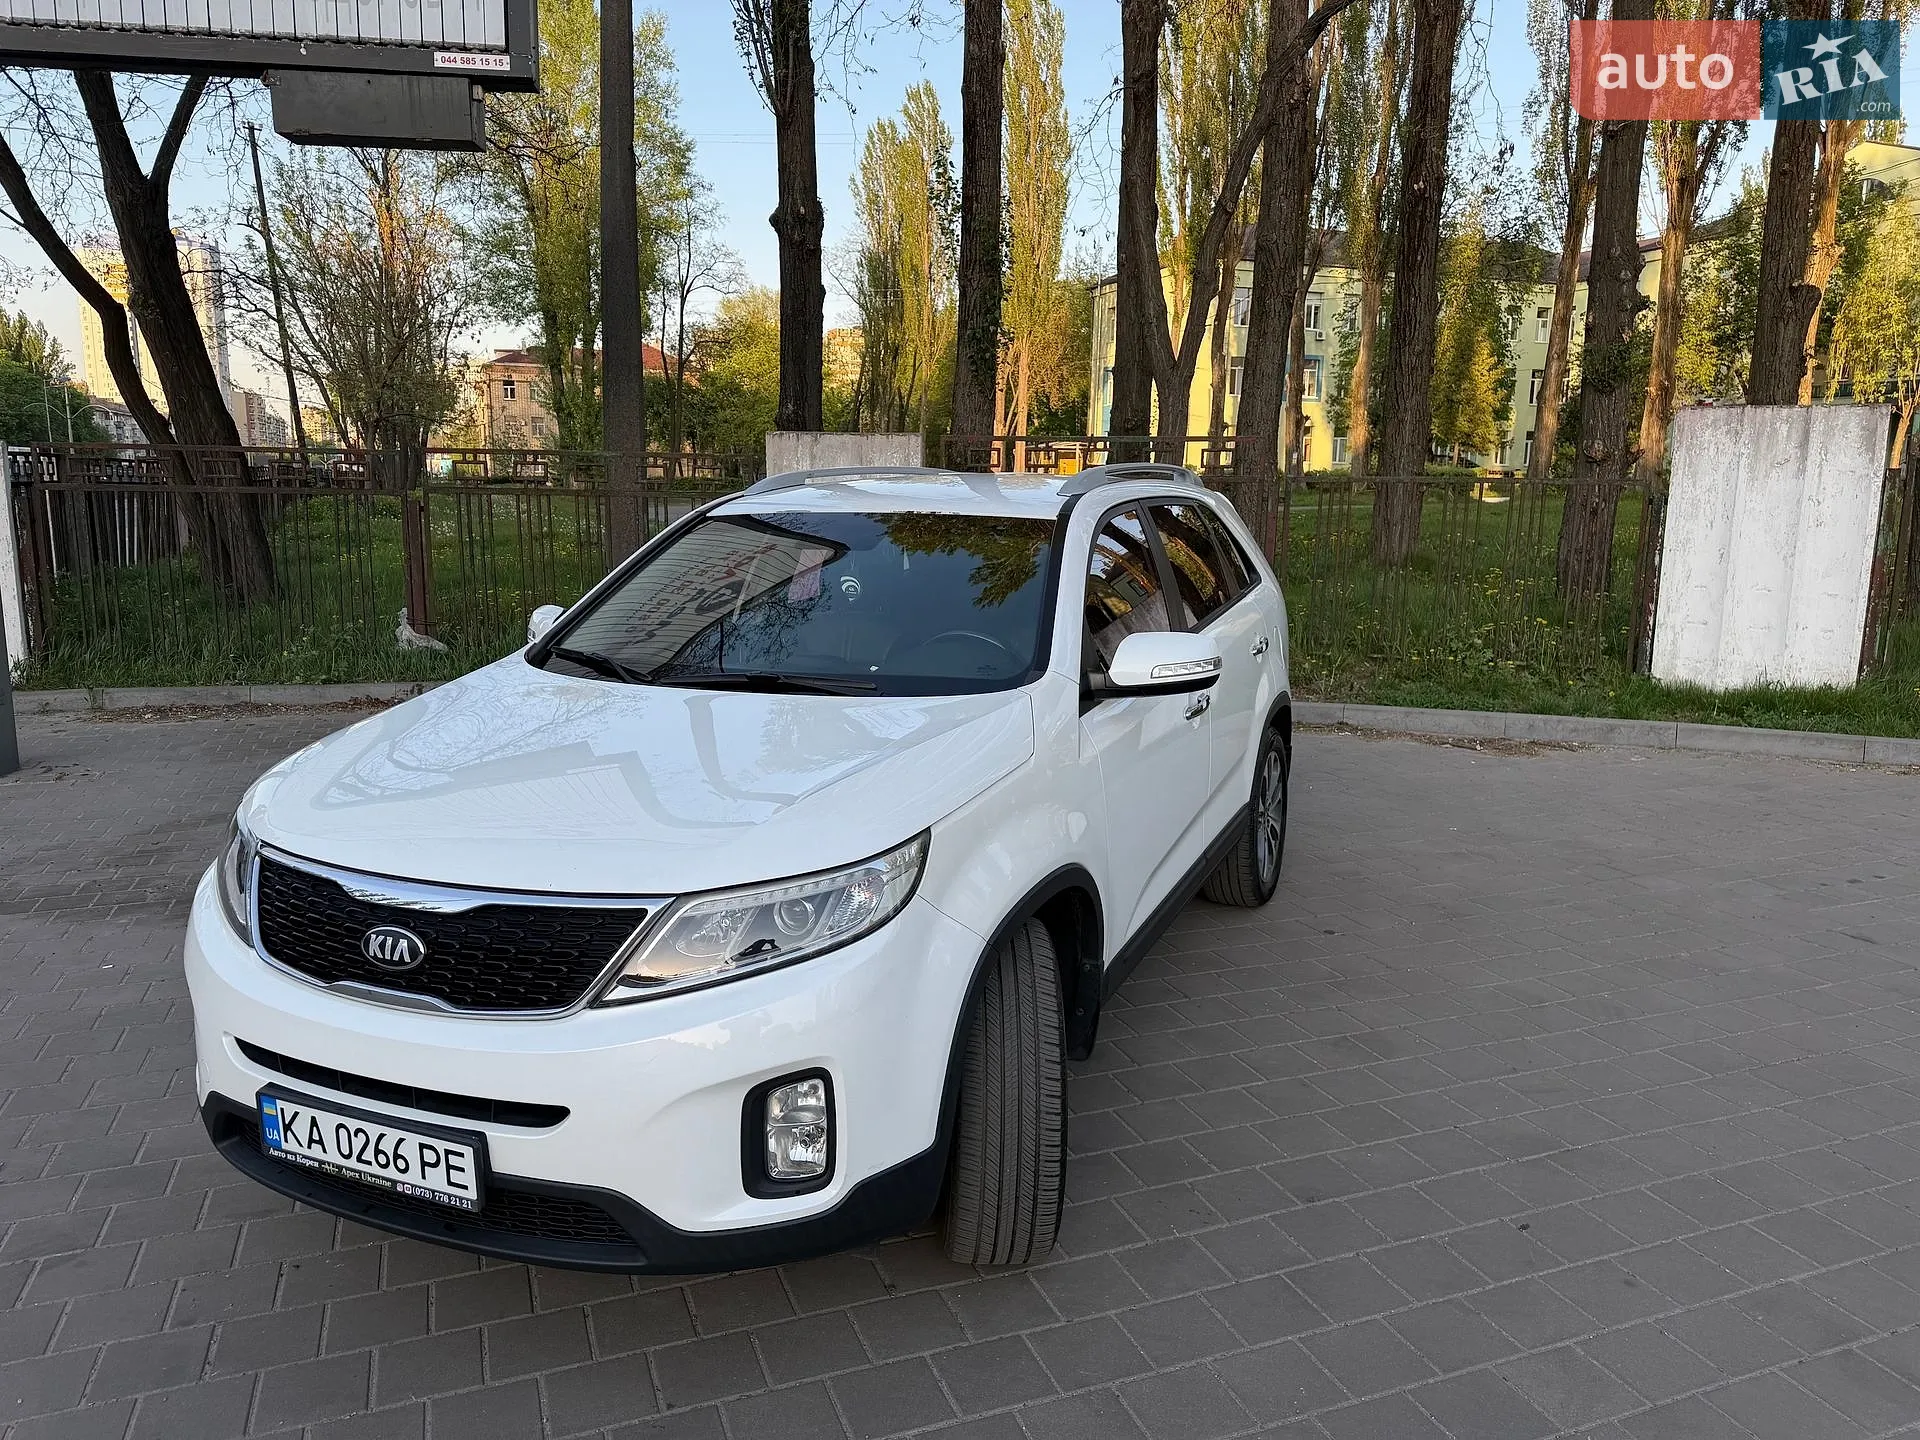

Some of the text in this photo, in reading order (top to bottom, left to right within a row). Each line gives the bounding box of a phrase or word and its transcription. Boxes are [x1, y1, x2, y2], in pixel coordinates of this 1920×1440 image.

[440, 55, 504, 67] 044 585 15 15
[368, 933, 412, 963] KIA
[266, 1126, 280, 1142] UA
[279, 1106, 469, 1190] KA 0266 PE
[341, 1168, 392, 1188] Apex Ukraine
[412, 1185, 433, 1200] (073)
[450, 1196, 461, 1207] 21
[462, 1199, 473, 1210] 21
